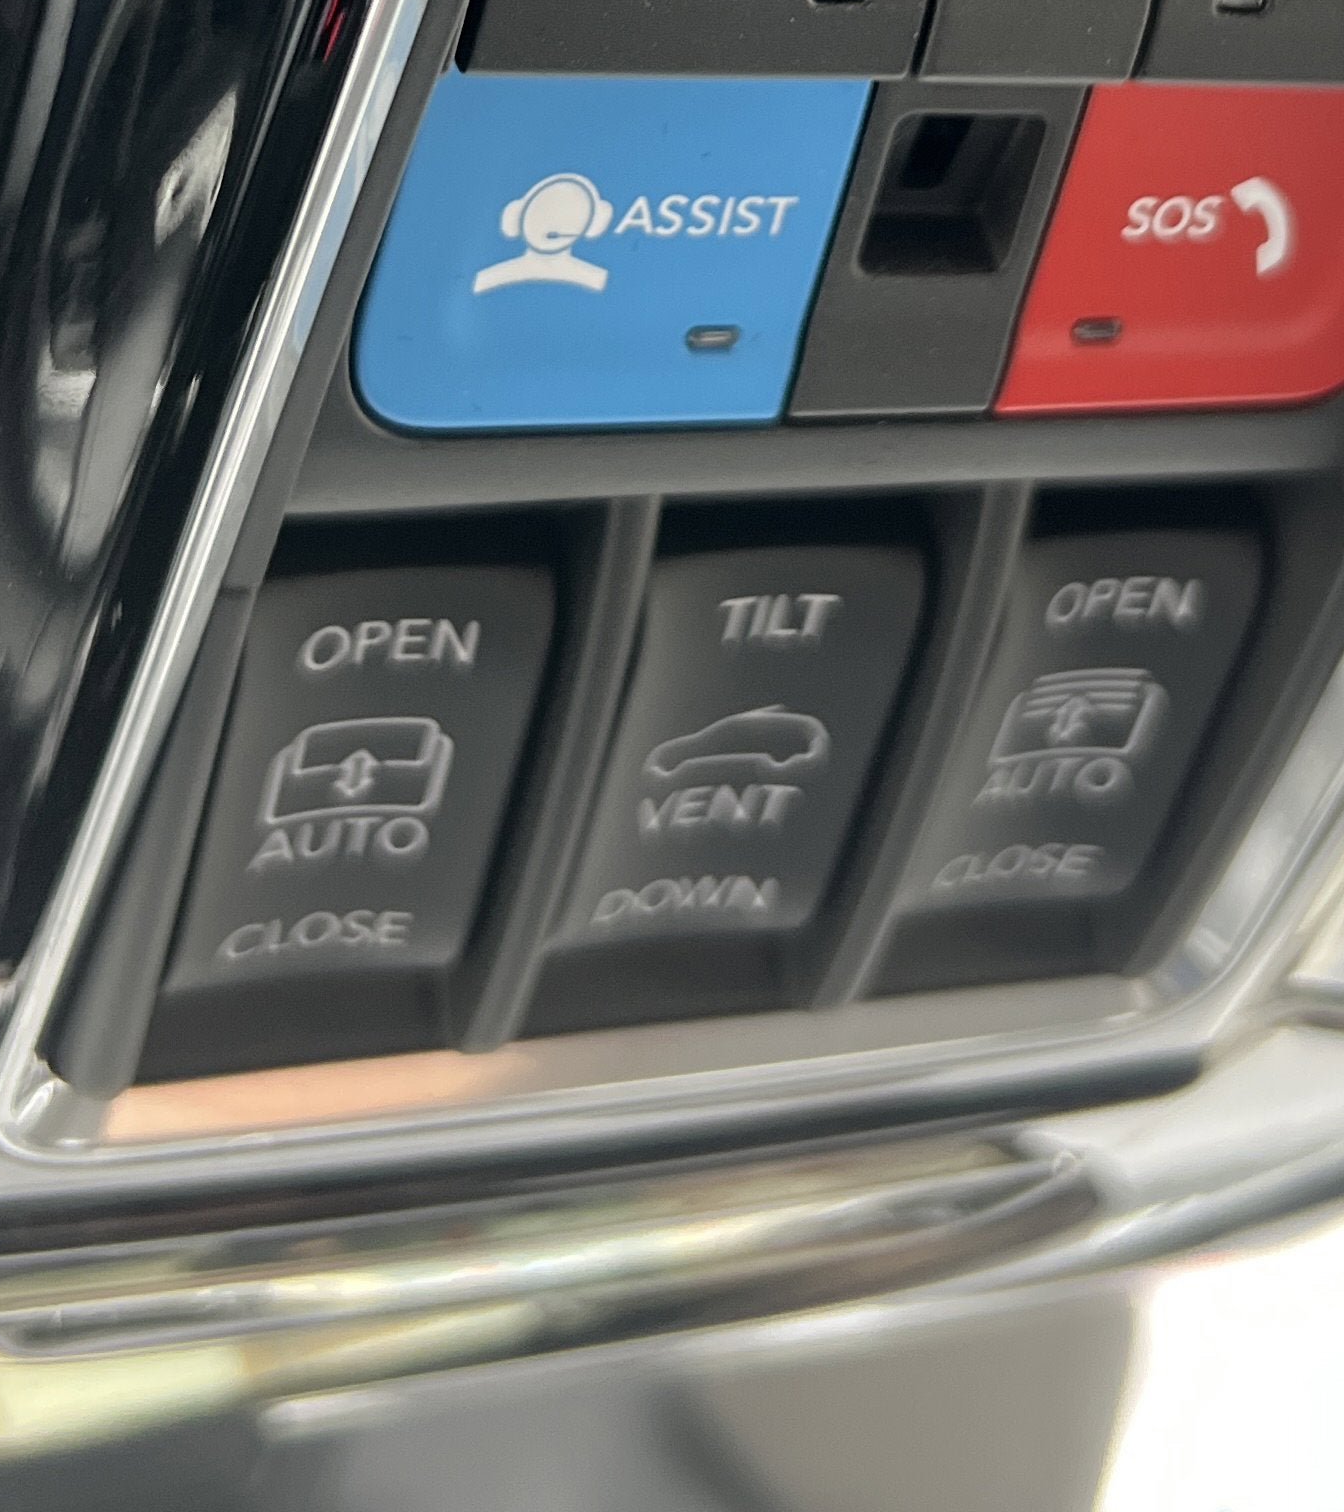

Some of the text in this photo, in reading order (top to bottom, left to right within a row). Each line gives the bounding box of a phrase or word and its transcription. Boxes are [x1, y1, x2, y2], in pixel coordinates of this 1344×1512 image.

[614, 195, 800, 237] ASSIST
[1119, 194, 1226, 241] SOS
[719, 593, 840, 642] TILT
[1045, 575, 1206, 628] OPEN
[303, 619, 478, 672] OPEN
[975, 759, 1127, 804] AUTO
[639, 784, 799, 833] VENT
[248, 814, 430, 870] AUTO
[935, 844, 1099, 888] CLOSE
[592, 876, 777, 925] DOWN
[221, 911, 412, 961] CLOSE
